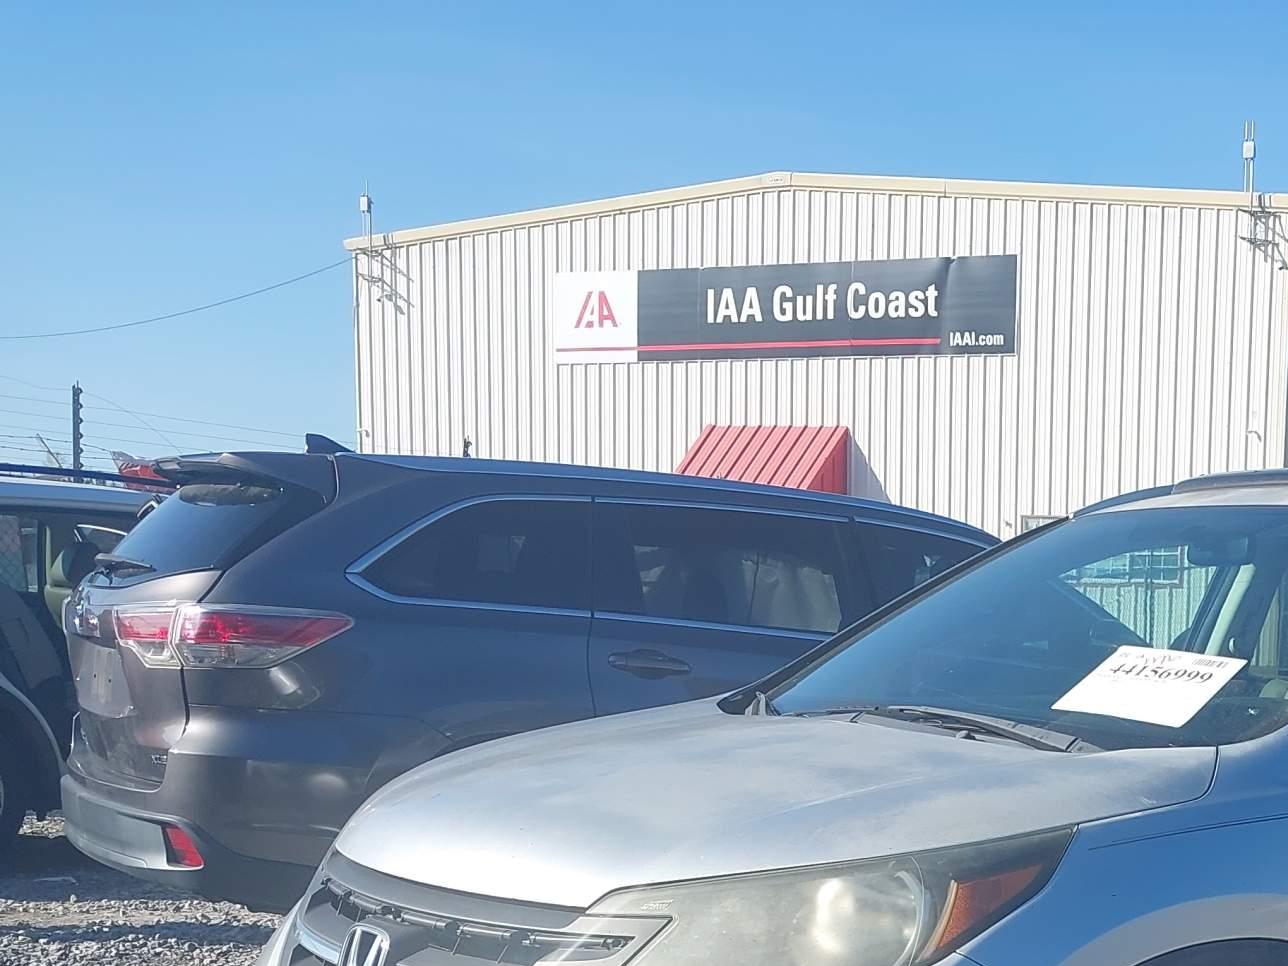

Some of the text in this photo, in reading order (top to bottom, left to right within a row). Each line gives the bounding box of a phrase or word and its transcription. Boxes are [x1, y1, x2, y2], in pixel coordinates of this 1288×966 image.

[706, 281, 939, 324] IAA Gulf Coast
[949, 331, 1004, 347] IAAI.com
[1109, 663, 1214, 684] 44156999
